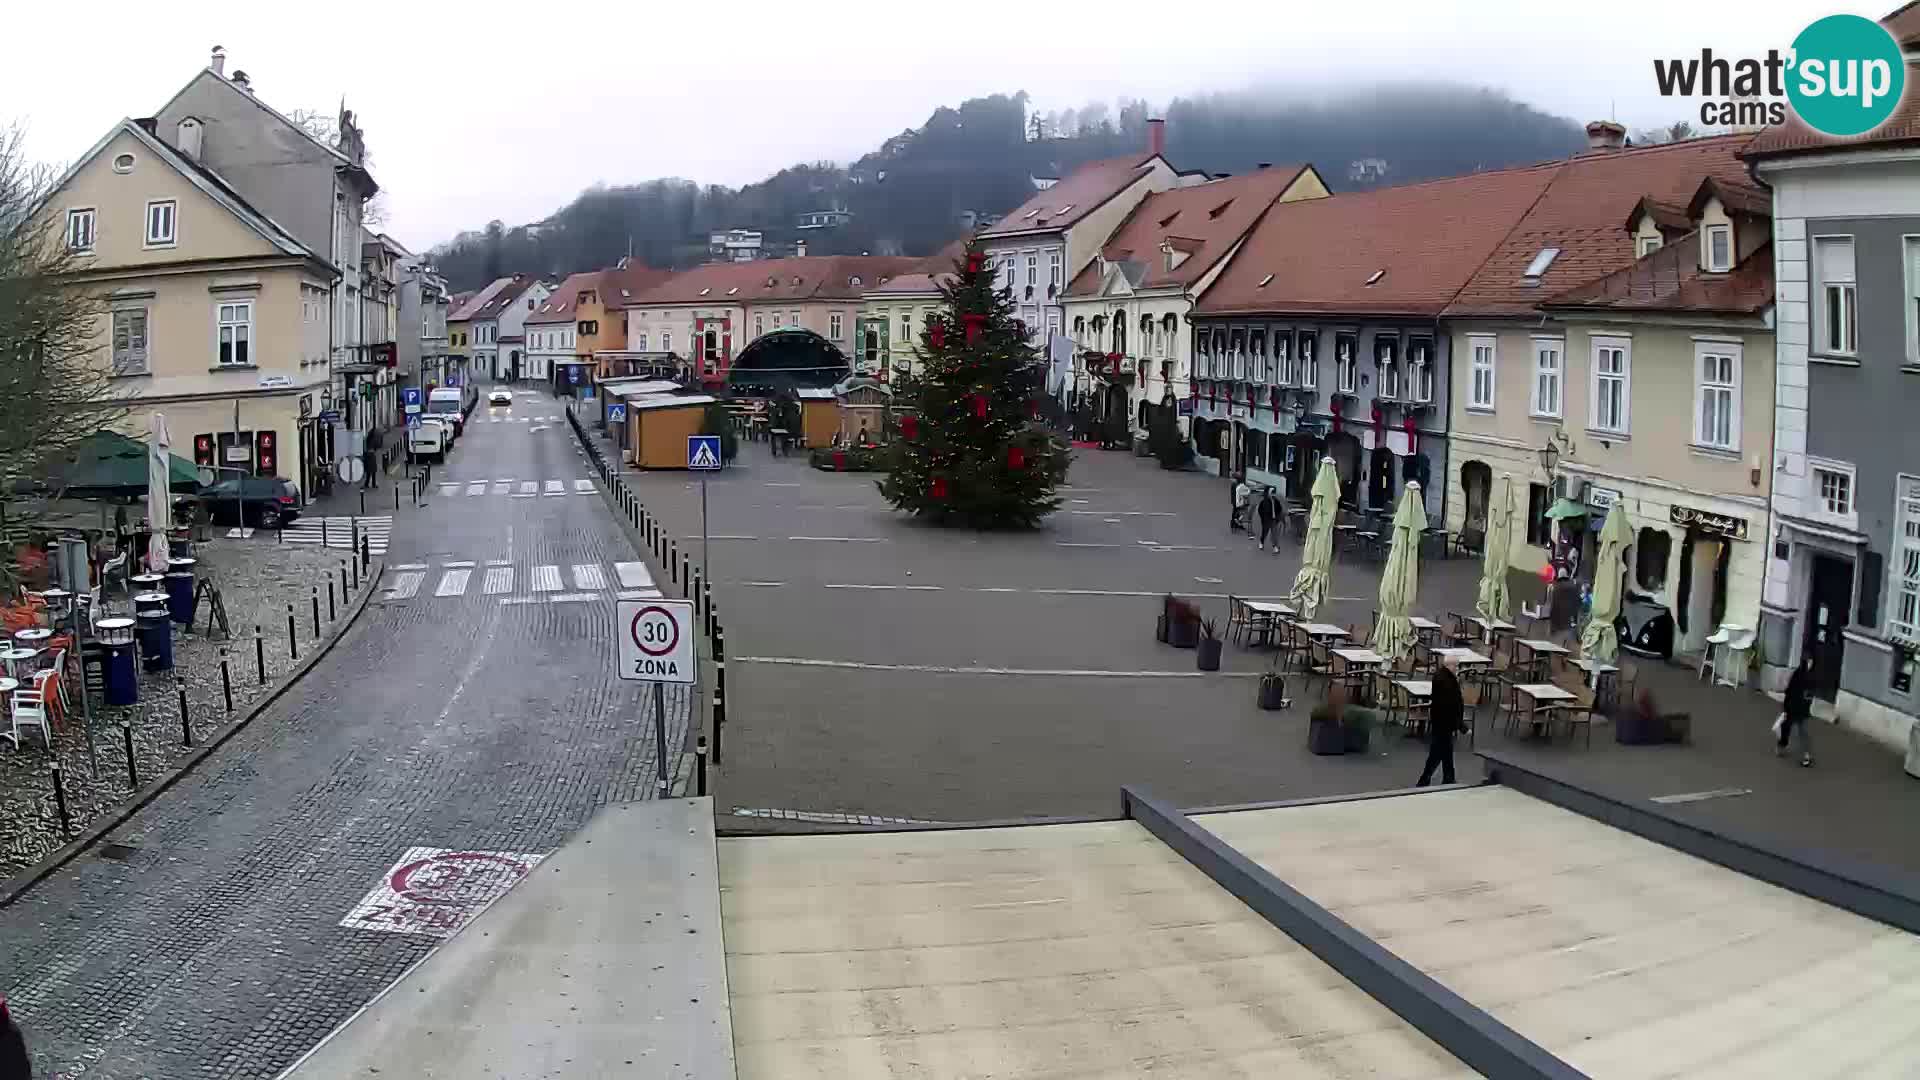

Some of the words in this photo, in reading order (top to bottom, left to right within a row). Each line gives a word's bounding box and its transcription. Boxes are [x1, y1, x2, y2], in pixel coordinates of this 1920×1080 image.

[409, 391, 417, 402] P
[644, 622, 667, 642] 30
[634, 659, 678, 676] ZONA
